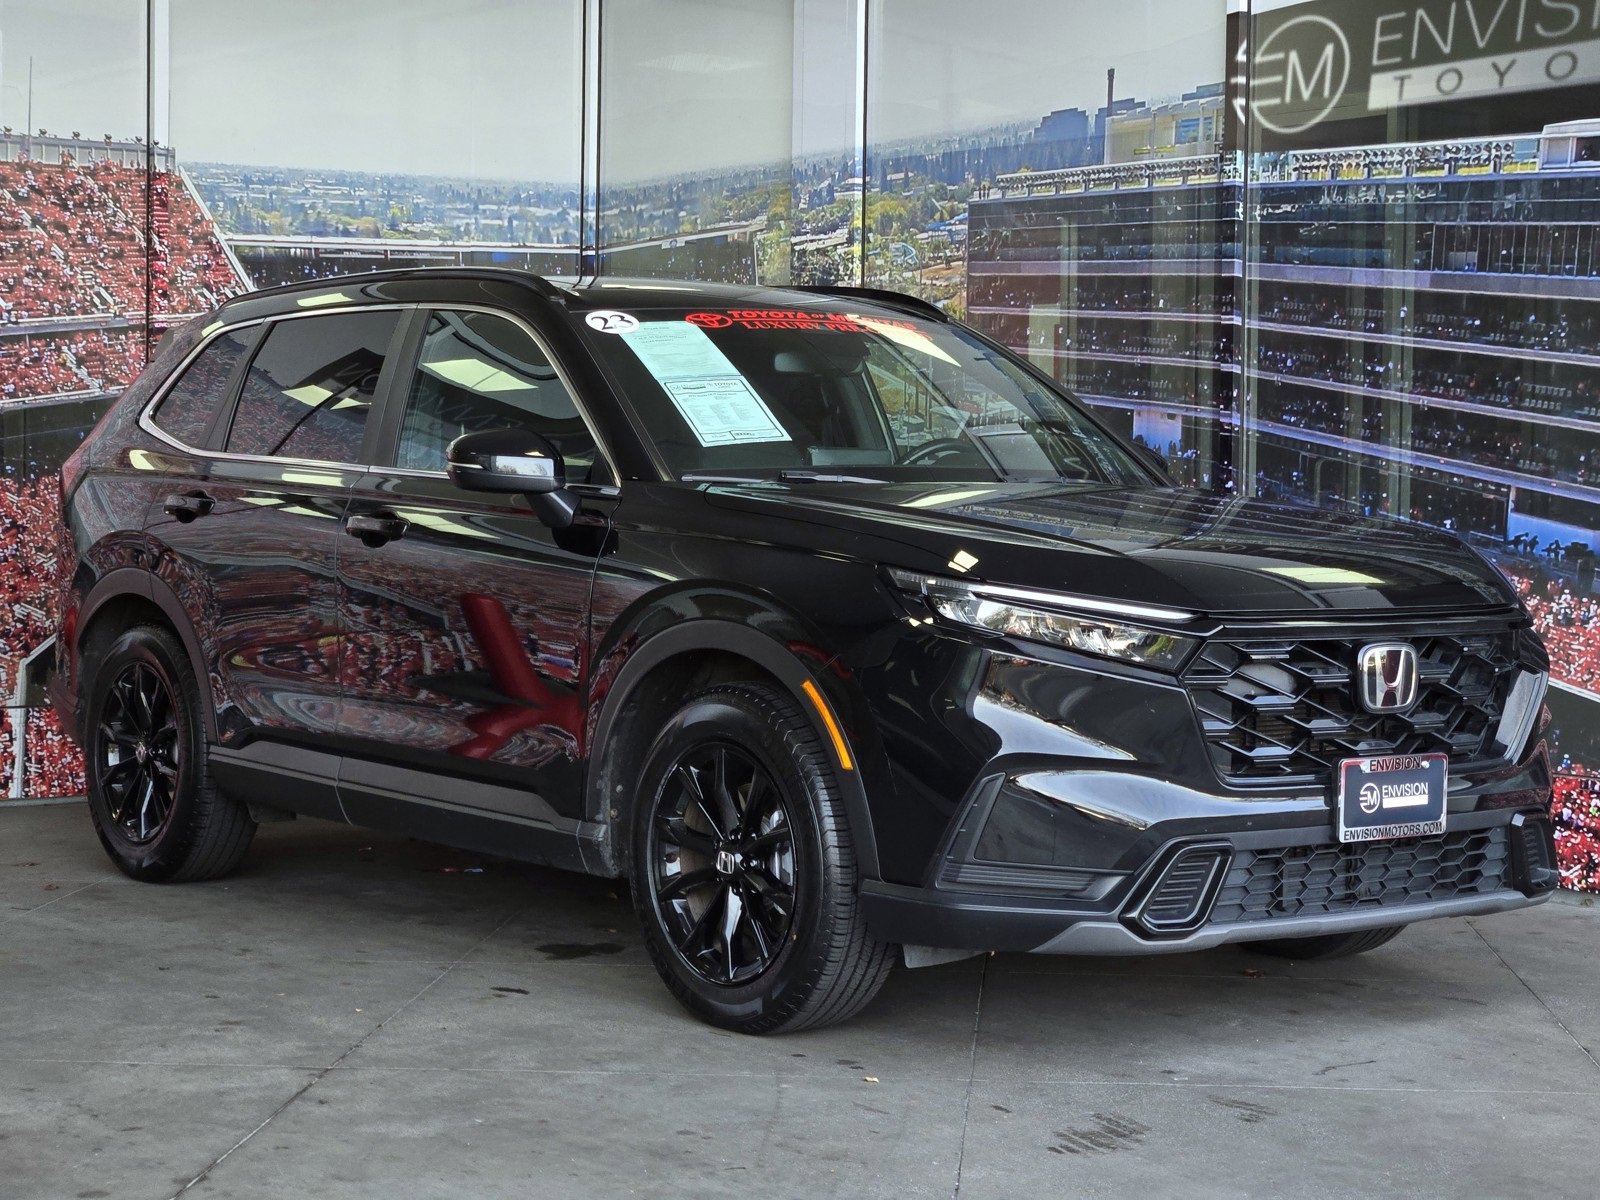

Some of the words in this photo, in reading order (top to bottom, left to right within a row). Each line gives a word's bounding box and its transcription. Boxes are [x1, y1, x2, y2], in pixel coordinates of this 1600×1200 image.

[591, 315, 634, 330] 23
[727, 310, 811, 320] TOYOTA
[1370, 756, 1421, 772] ENVISION
[1382, 782, 1428, 798] ENVISION
[1344, 822, 1442, 841] ENVISIONMOTORS.COM
